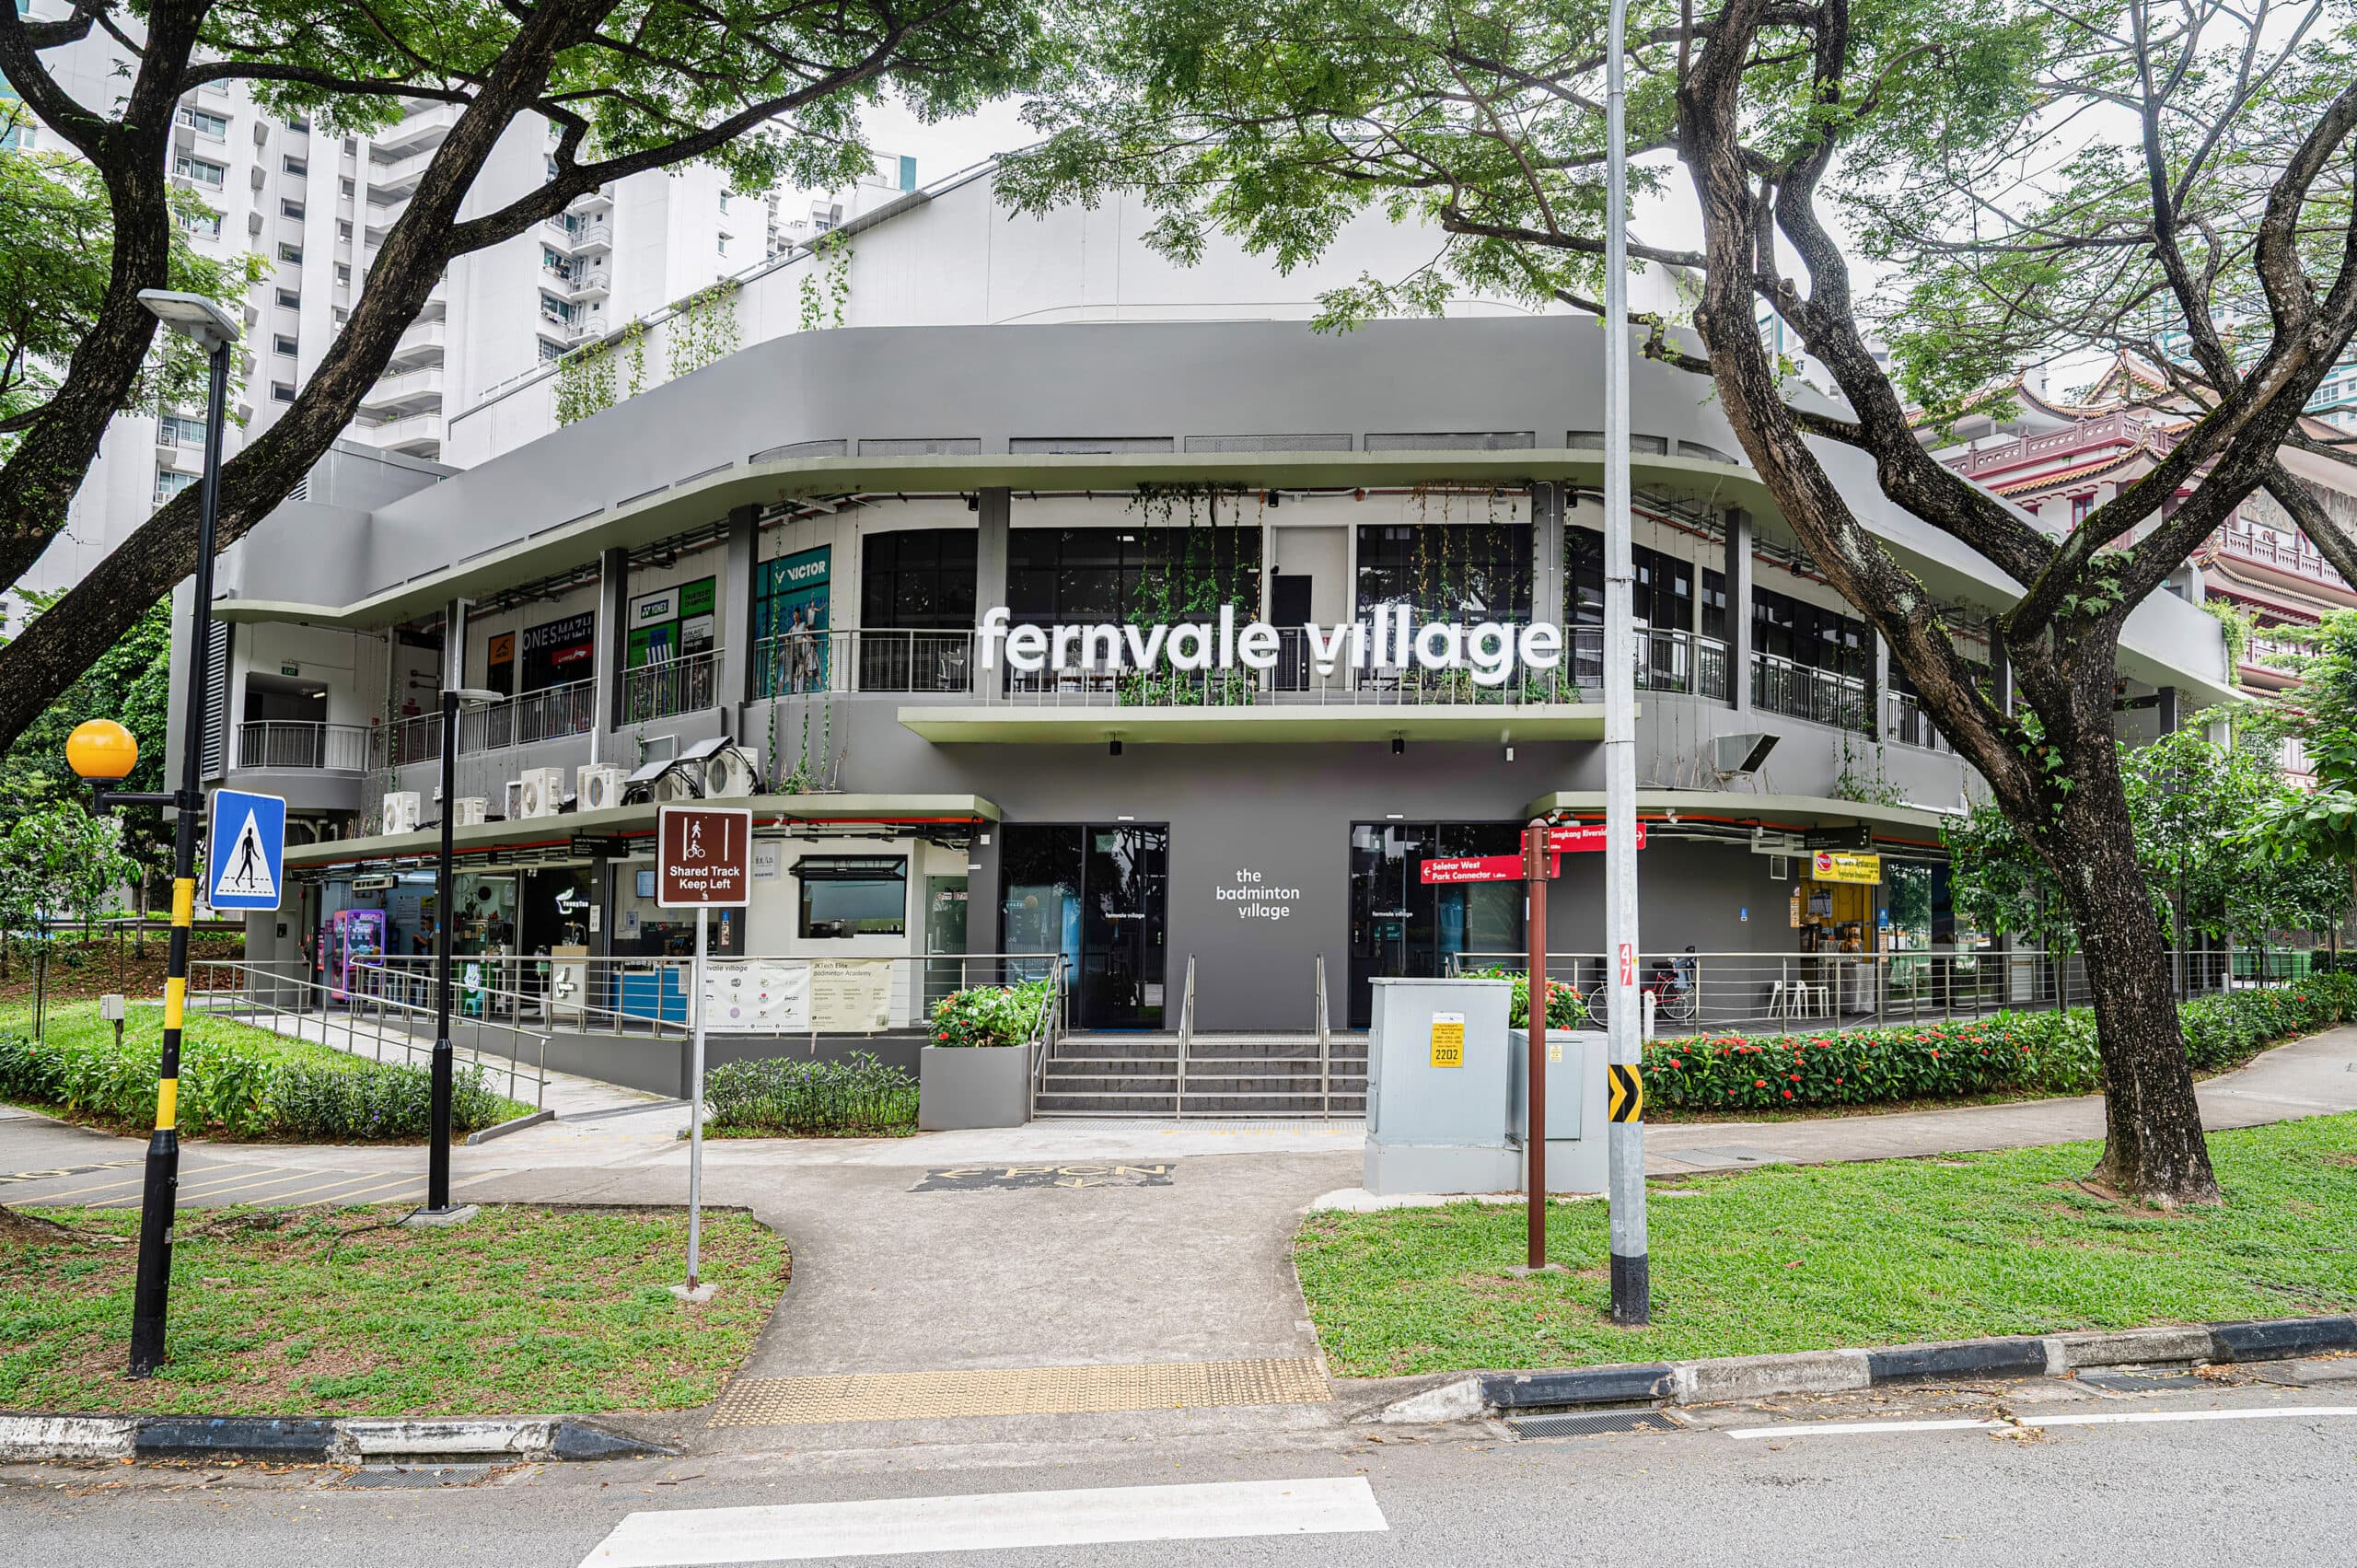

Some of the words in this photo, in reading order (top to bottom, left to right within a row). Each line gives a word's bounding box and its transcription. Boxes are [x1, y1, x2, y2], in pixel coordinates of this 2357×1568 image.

[787, 561, 826, 580] VICTOR
[652, 602, 668, 614] YONEX
[978, 605, 1280, 671] fernvale
[1304, 604, 1563, 685] village
[1550, 830, 1582, 840] Sengkang
[670, 866, 708, 877] Shared
[711, 866, 740, 877] Track
[1433, 862, 1458, 870] Seletar
[1460, 861, 1480, 869] West
[1236, 868, 1261, 882] the
[1432, 872, 1450, 880] Park
[1452, 871, 1490, 880] Connector
[679, 878, 707, 891] Keep
[710, 878, 731, 889] Left
[1216, 886, 1300, 900] badminton
[1238, 902, 1290, 920] village
[1435, 1049, 1458, 1060] 2202
[1005, 1165, 1166, 1177] PCN
